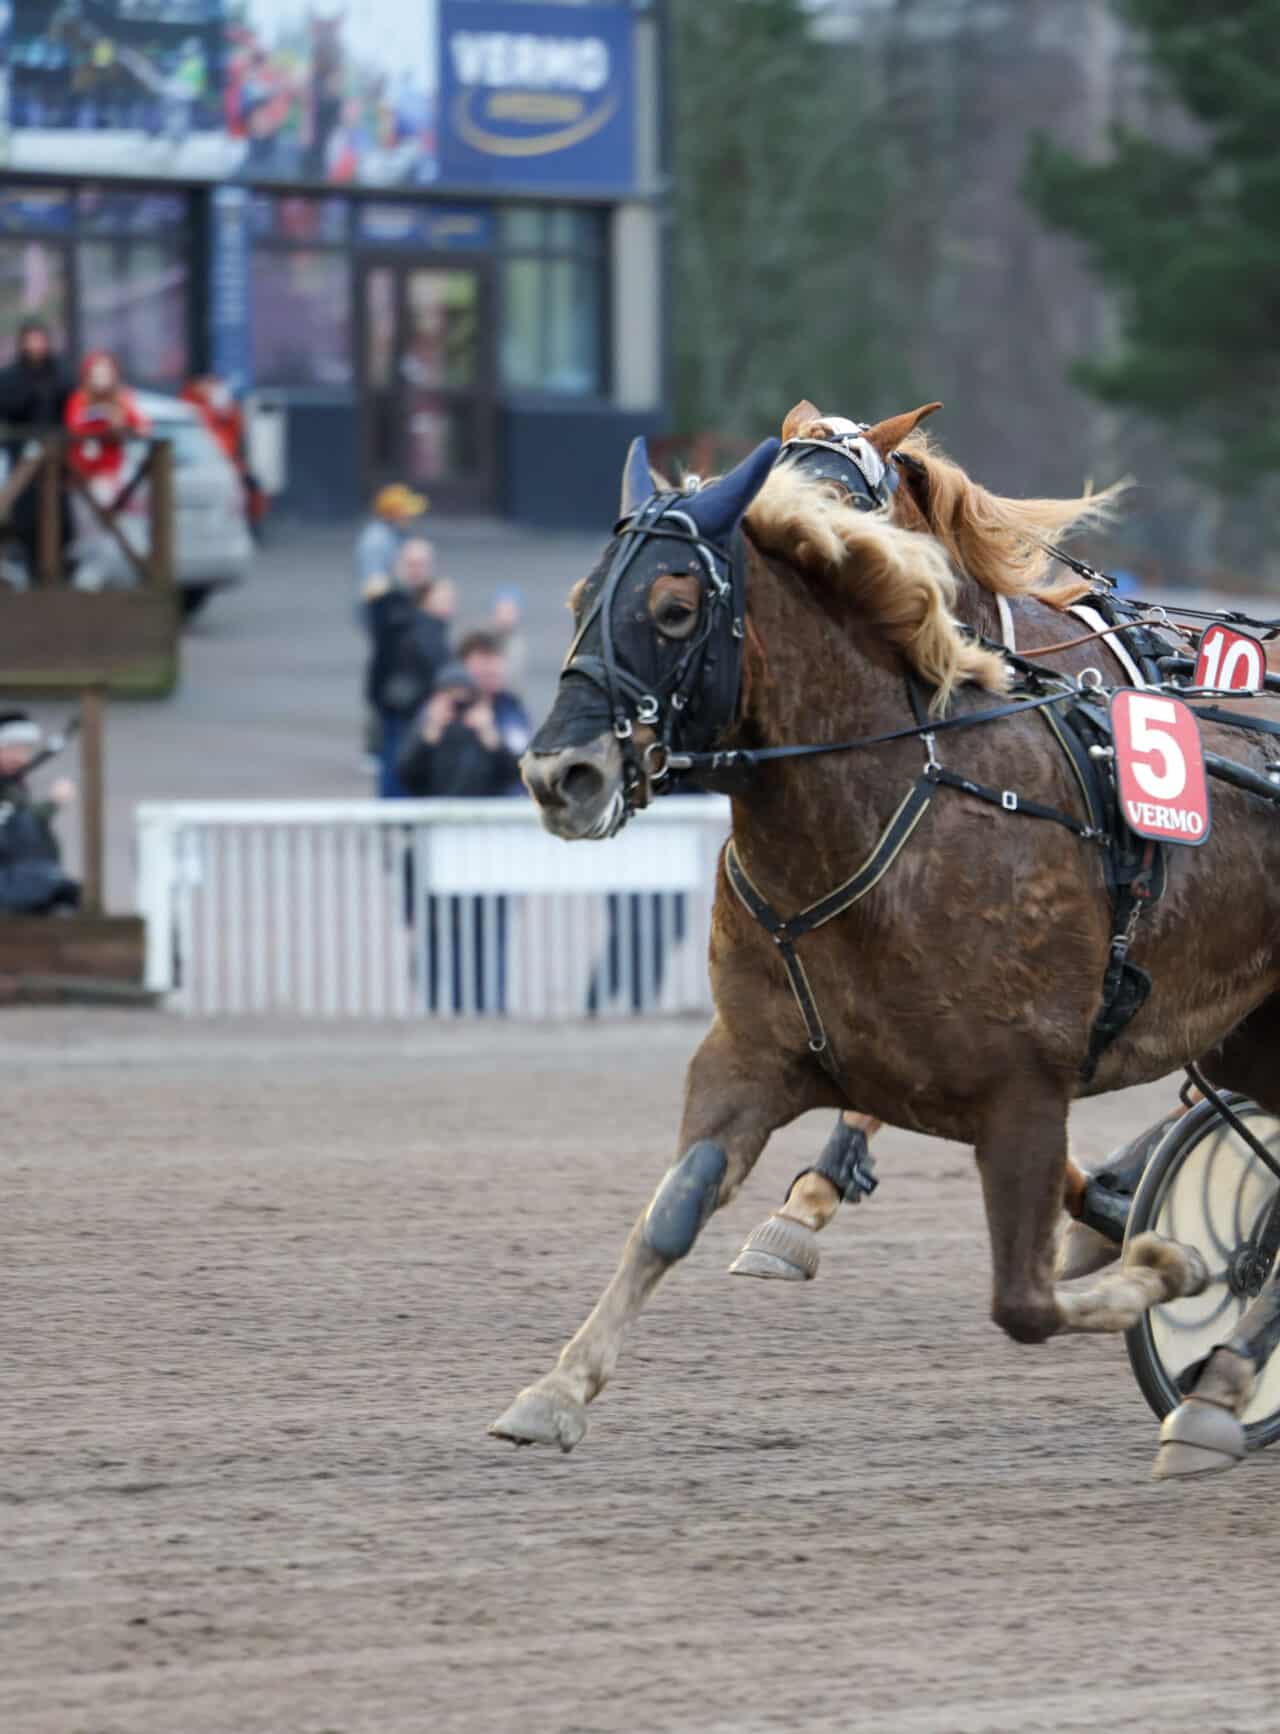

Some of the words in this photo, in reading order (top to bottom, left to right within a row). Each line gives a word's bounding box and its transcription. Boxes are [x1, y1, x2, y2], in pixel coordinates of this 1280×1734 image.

[449, 31, 610, 91] VERMO
[1202, 631, 1261, 691] 10
[1127, 695, 1187, 800] 5
[1127, 800, 1204, 835] VERMO
